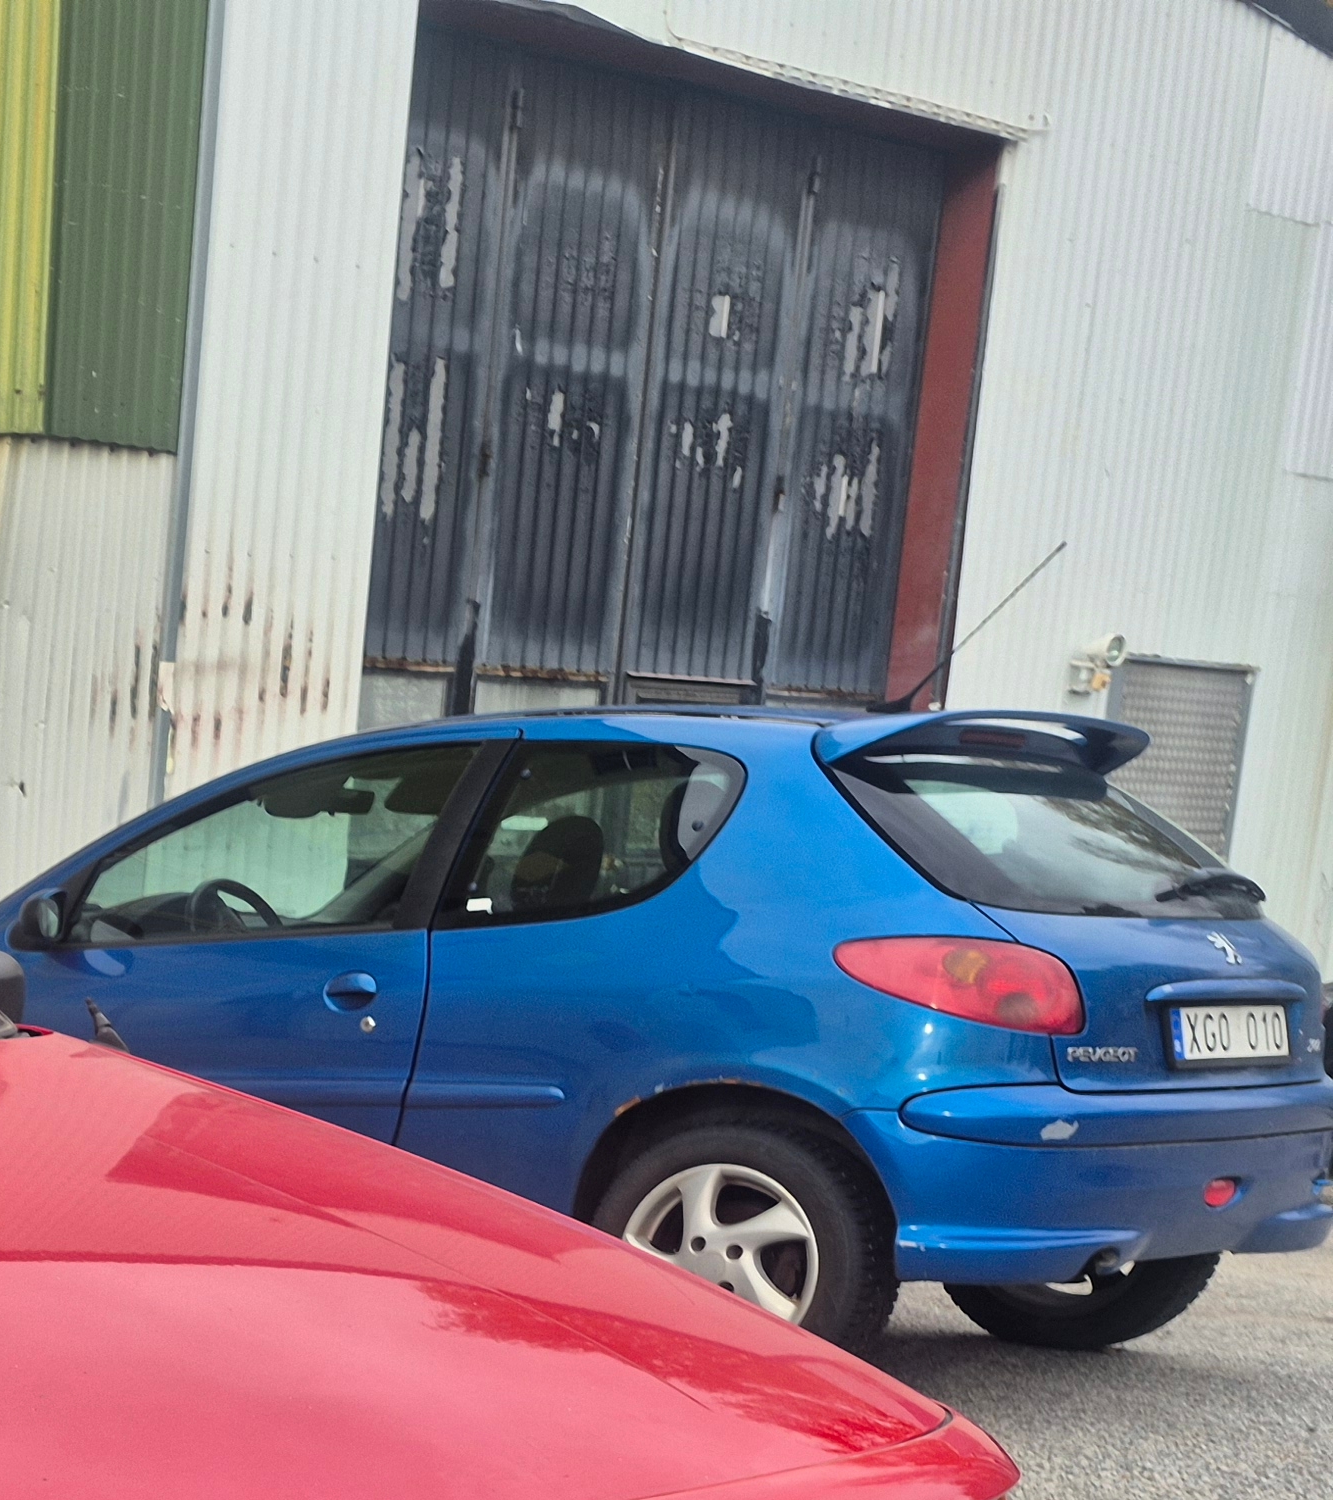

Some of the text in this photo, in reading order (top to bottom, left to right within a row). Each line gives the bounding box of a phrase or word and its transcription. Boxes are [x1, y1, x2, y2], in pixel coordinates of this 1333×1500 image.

[1186, 1011, 1284, 1053] XGO 010
[1066, 1046, 1139, 1063] PEUGEOT
